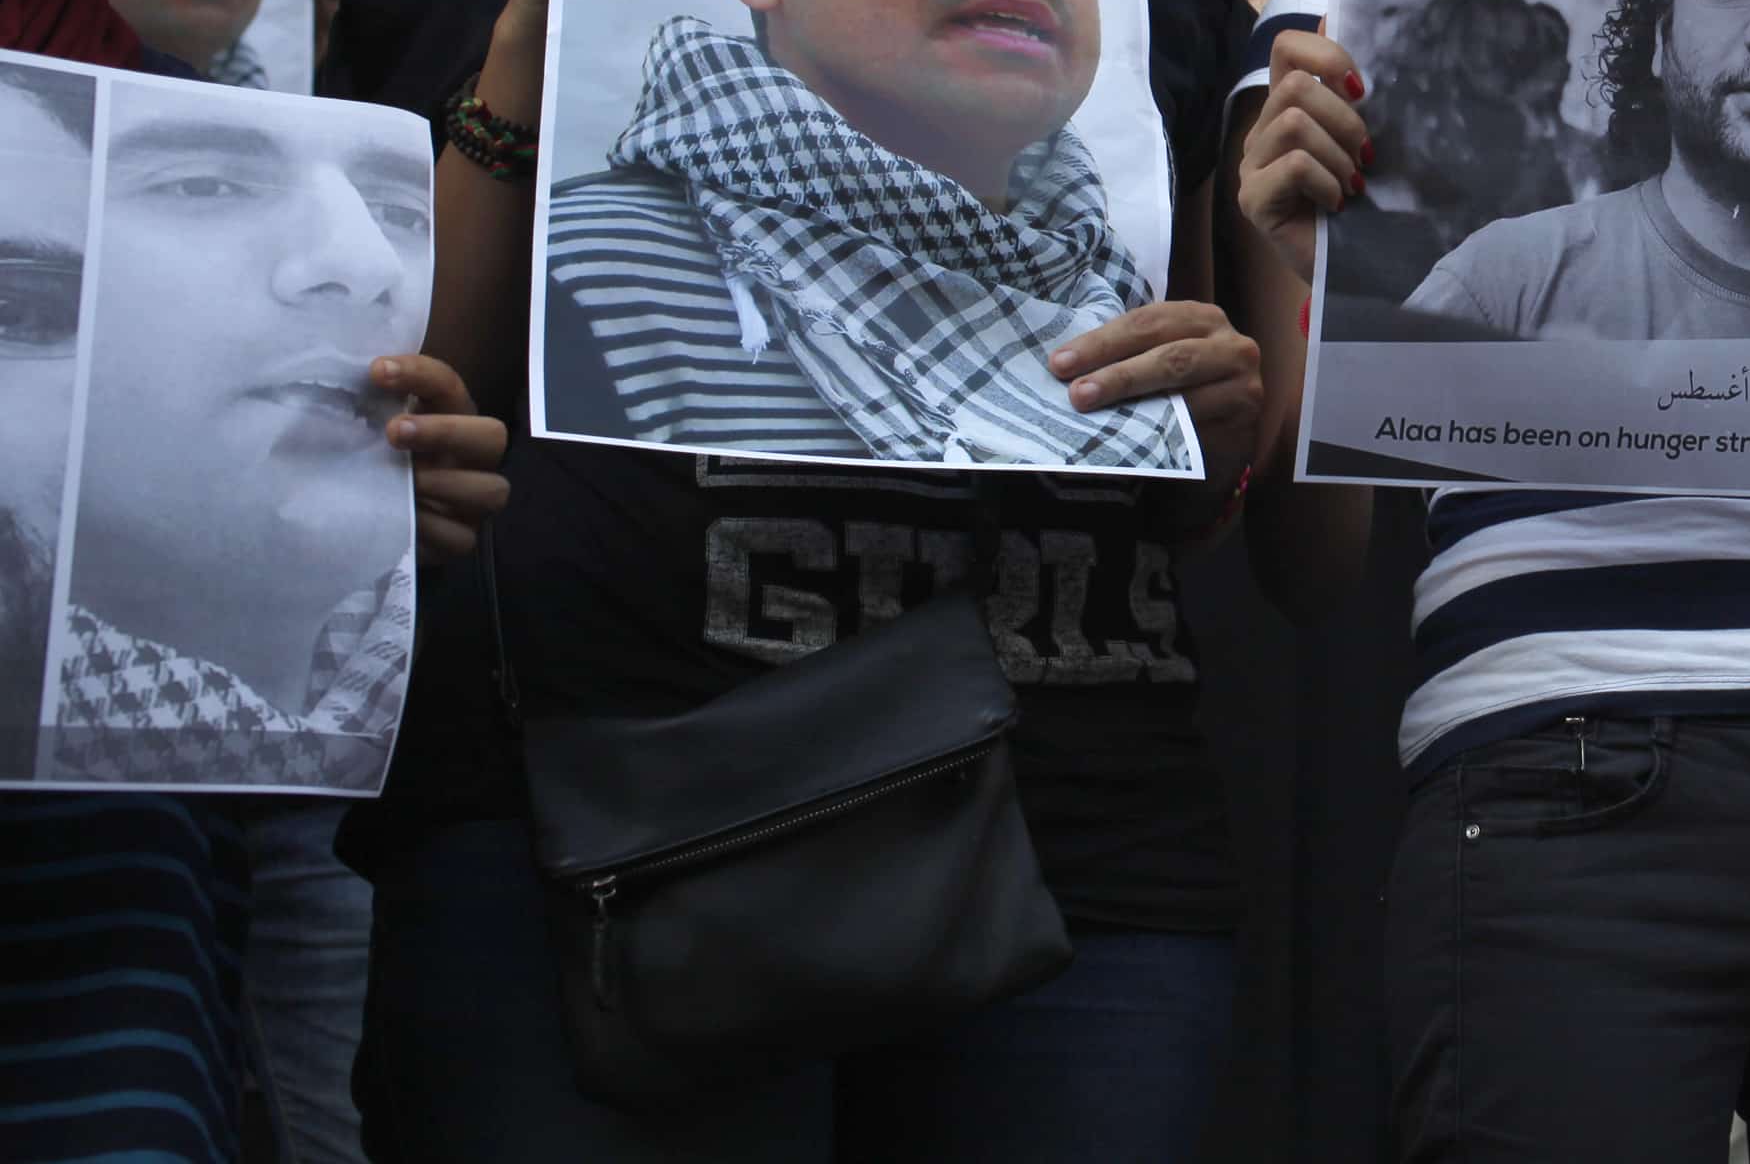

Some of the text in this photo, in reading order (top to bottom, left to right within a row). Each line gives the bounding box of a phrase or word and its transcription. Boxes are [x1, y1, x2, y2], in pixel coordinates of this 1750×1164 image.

[1657, 365, 1749, 411] أغسطس
[1374, 416, 1442, 443] Alaa
[1448, 419, 1497, 445] has
[1502, 421, 1571, 448] been
[1577, 429, 1611, 449] on
[1617, 426, 1711, 460] hunger
